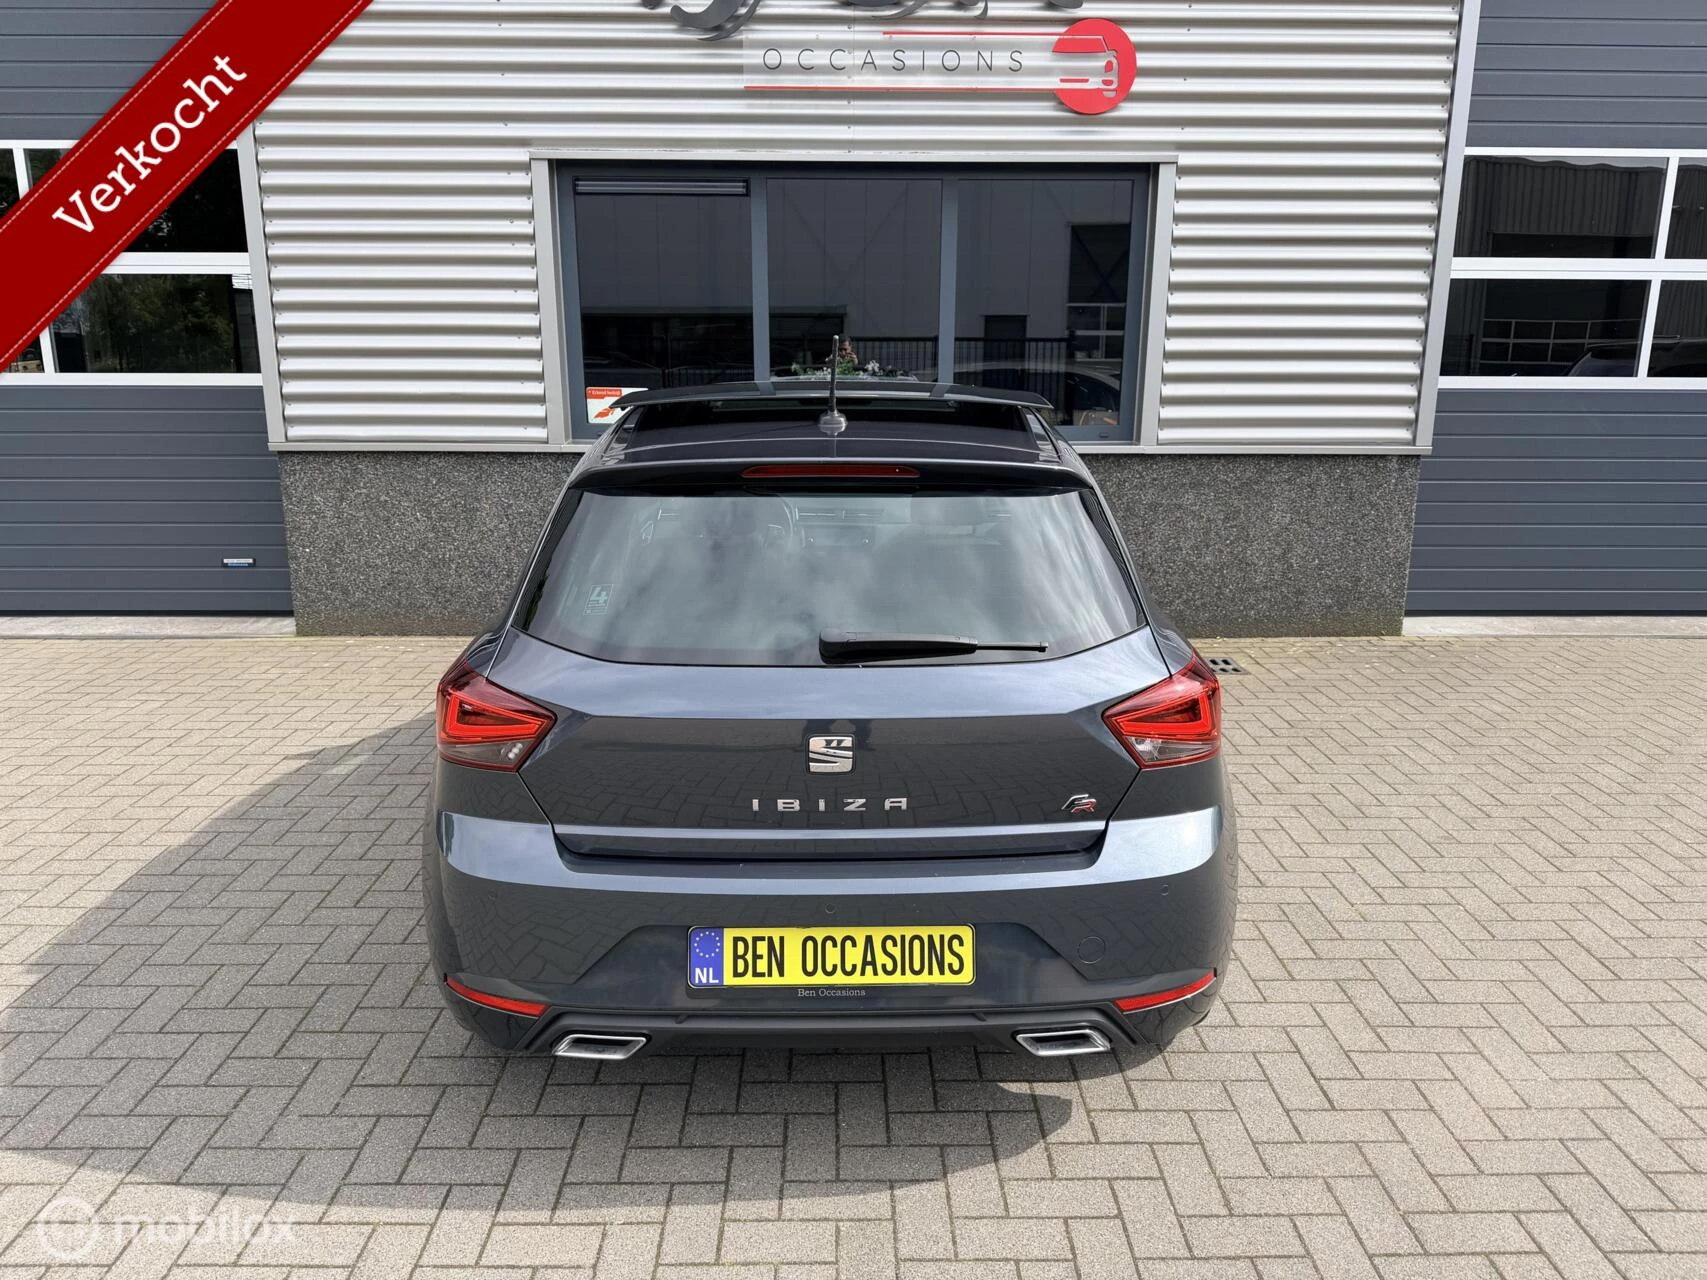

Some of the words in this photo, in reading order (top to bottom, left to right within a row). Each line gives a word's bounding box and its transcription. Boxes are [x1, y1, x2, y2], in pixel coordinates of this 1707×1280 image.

[762, 47, 1024, 73] OCCASIONS
[752, 797, 908, 812] IBIZA
[732, 935, 785, 978] BEN
[801, 934, 965, 977] OCCASIONS
[694, 967, 720, 984] NL
[797, 988, 816, 998] Ben
[818, 987, 866, 998] Occasions
